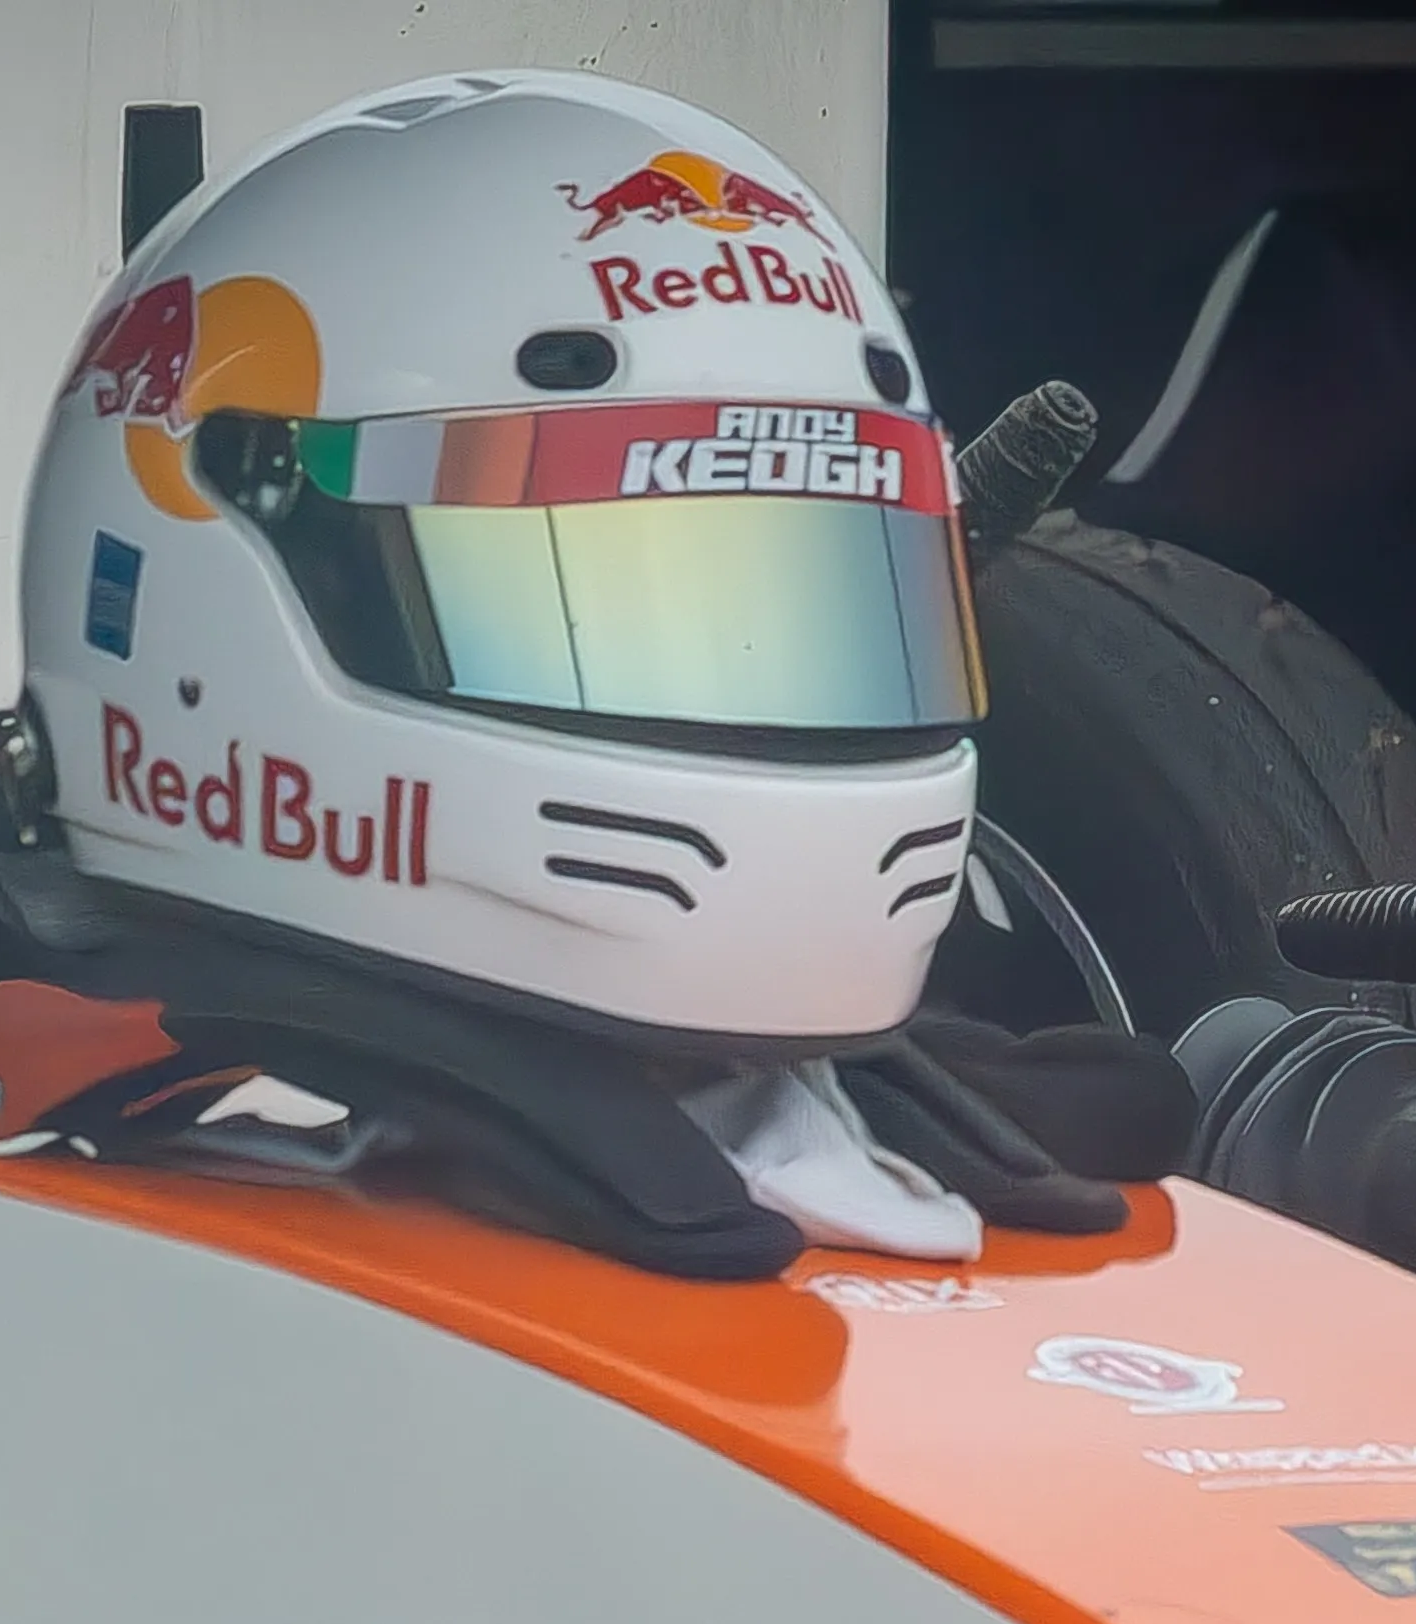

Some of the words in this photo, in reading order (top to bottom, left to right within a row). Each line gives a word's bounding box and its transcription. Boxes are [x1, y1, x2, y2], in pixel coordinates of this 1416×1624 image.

[589, 240, 751, 322] Red
[745, 244, 863, 325] Bull
[620, 438, 903, 501] KEOGH
[101, 700, 243, 848] Red
[260, 754, 432, 887] Bull
